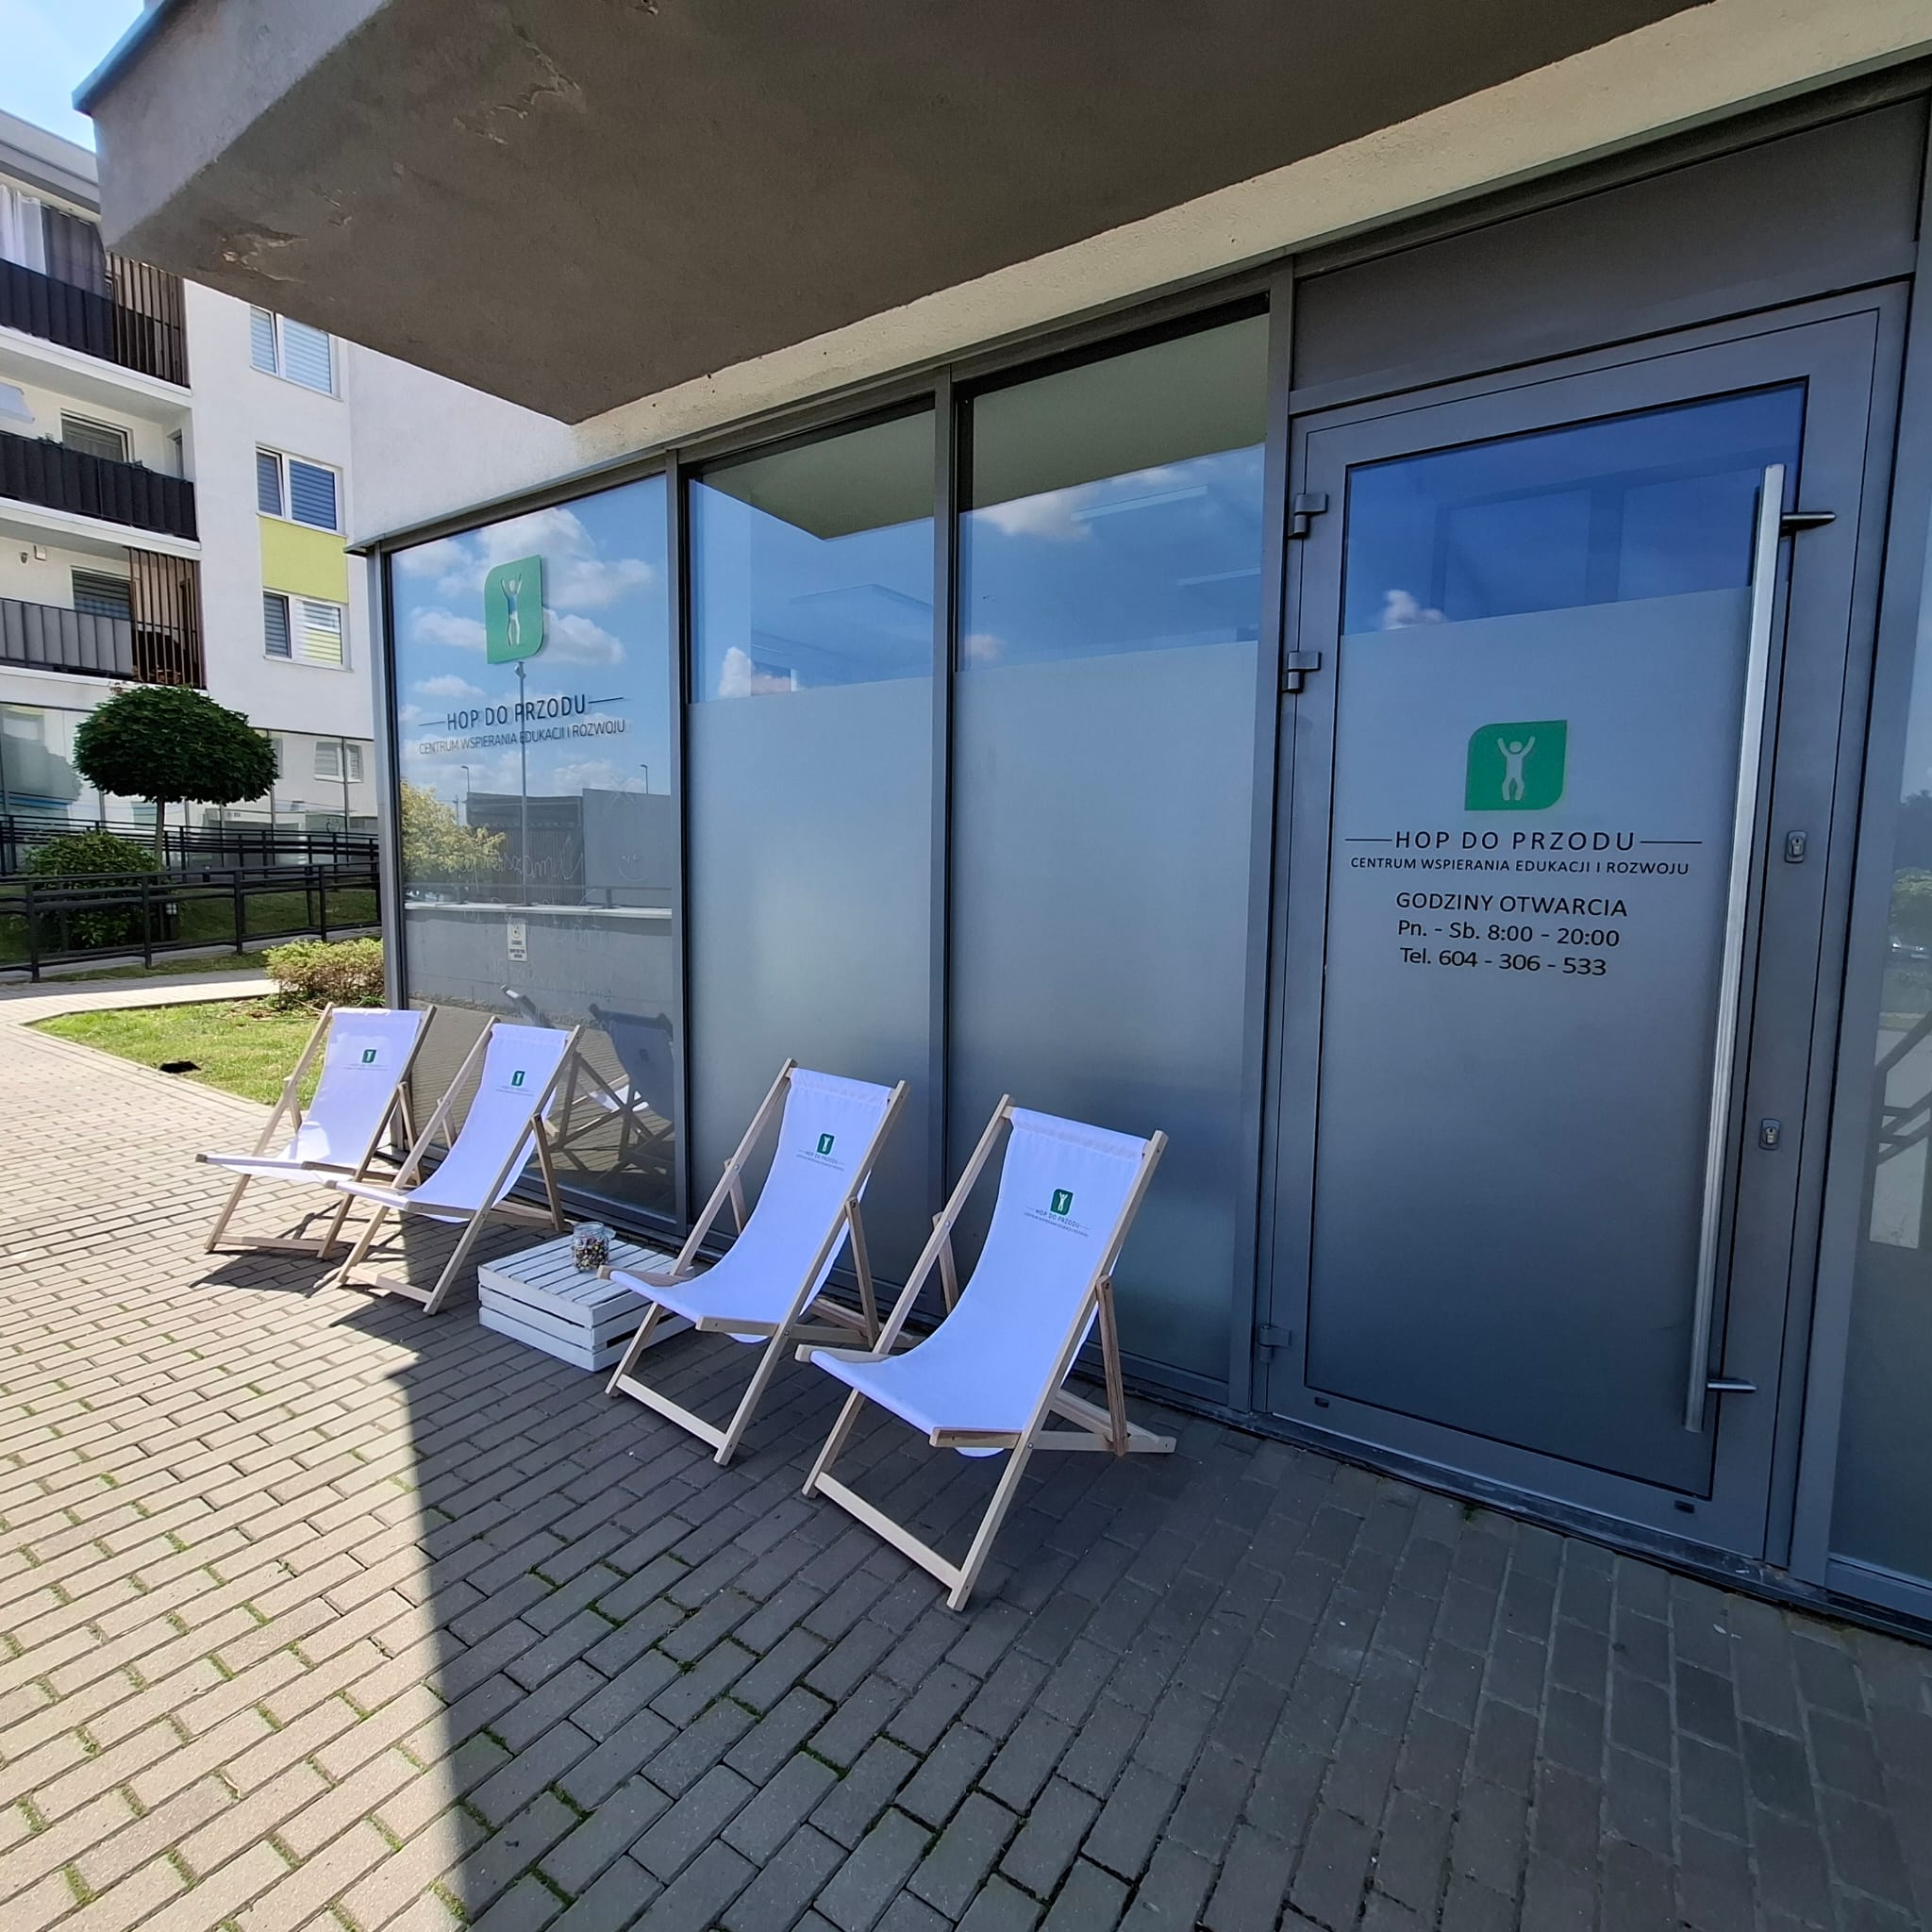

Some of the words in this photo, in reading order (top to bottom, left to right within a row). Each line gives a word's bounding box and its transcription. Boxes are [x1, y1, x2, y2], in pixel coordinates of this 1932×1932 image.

[447, 709, 479, 731] HOP
[485, 705, 508, 725] DO
[514, 693, 586, 723] PRZODU
[419, 739, 459, 755] CENTRUM
[460, 732, 518, 750] WSPIERANIA
[519, 725, 565, 744] EDUKACJI
[572, 719, 625, 737] ROZWOJU
[1395, 831, 1450, 849] HOP
[1462, 831, 1500, 850] DO
[1512, 831, 1635, 851] PRZODU
[1350, 857, 1416, 870] CENTRUM
[1421, 858, 1510, 872] WSPIERANIA
[1515, 859, 1591, 874] EDUKACJI
[1596, 861, 1601, 873] I
[1606, 861, 1690, 875] ROZWOJU
[1396, 891, 1494, 913] GODZINY
[1499, 894, 1628, 918] OTWARCIA
[1398, 920, 1427, 938] Pn.
[1449, 923, 1480, 941] Sb.
[1487, 924, 1534, 942] 8:00
[1557, 927, 1621, 948] 20:00
[1400, 946, 1432, 965] Tel.
[1438, 950, 1478, 968] 604
[1498, 953, 1541, 972] 306
[1562, 957, 1607, 976] 533
